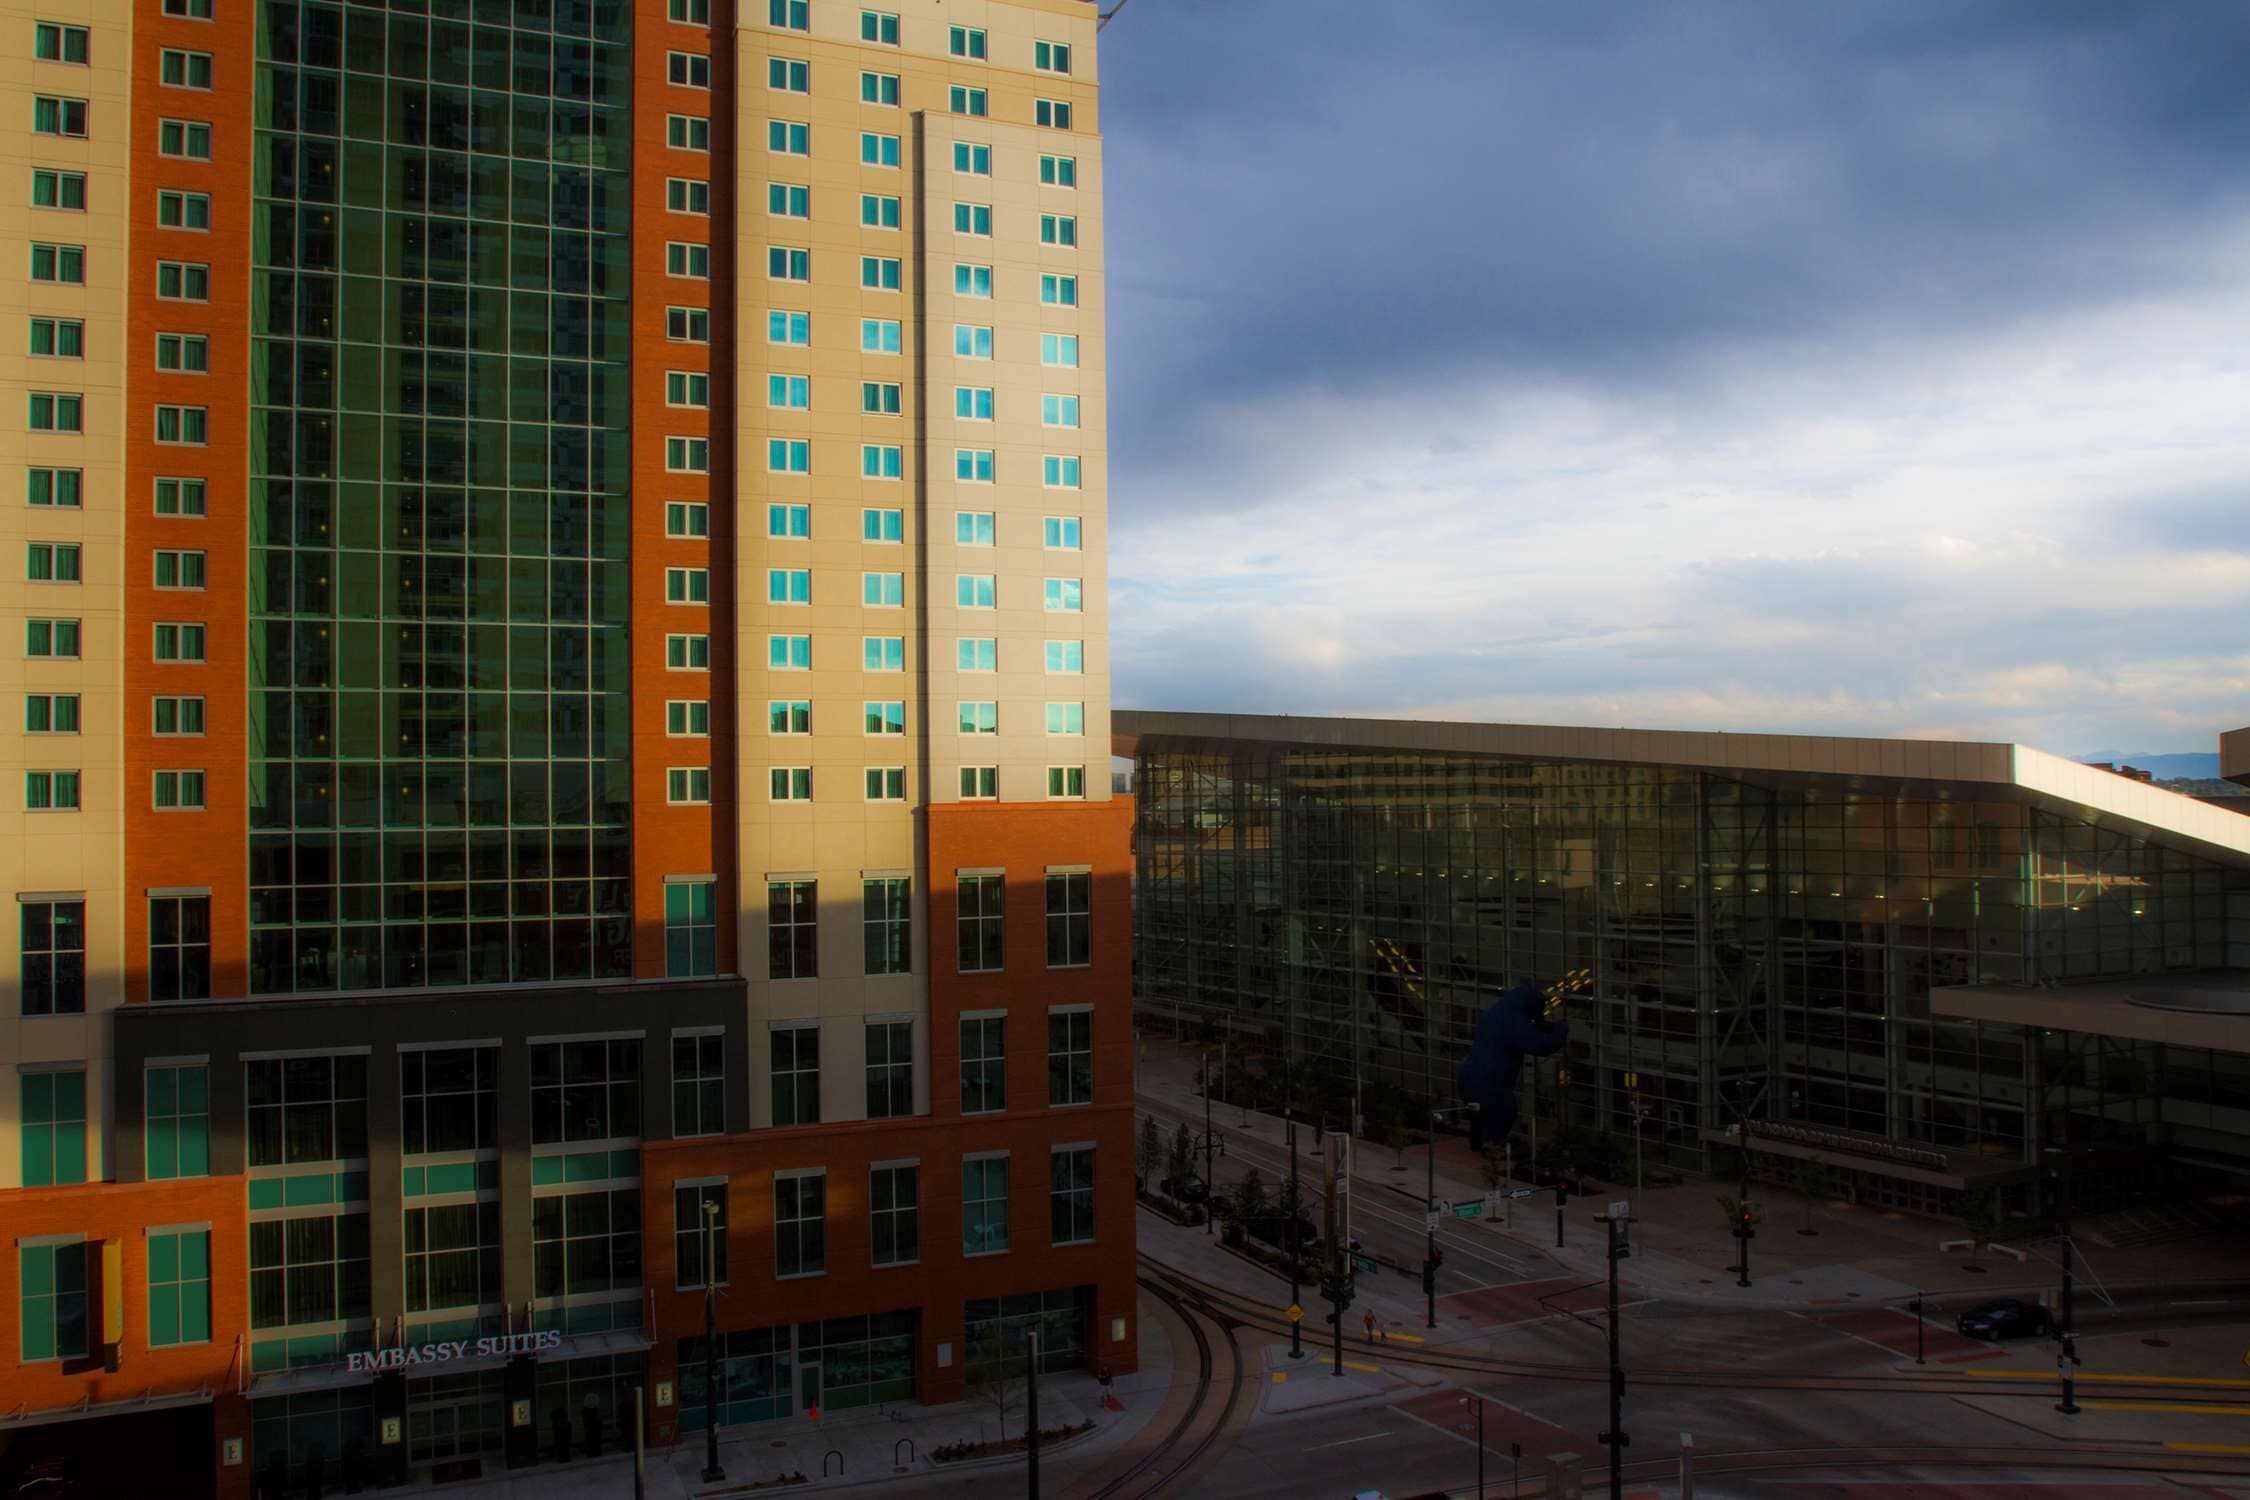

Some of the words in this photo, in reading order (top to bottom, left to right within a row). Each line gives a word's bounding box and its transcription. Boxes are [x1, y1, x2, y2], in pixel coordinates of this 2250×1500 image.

[346, 1340, 469, 1371] EMBASSY
[476, 1330, 561, 1357] SUITES
[387, 1424, 397, 1438] E
